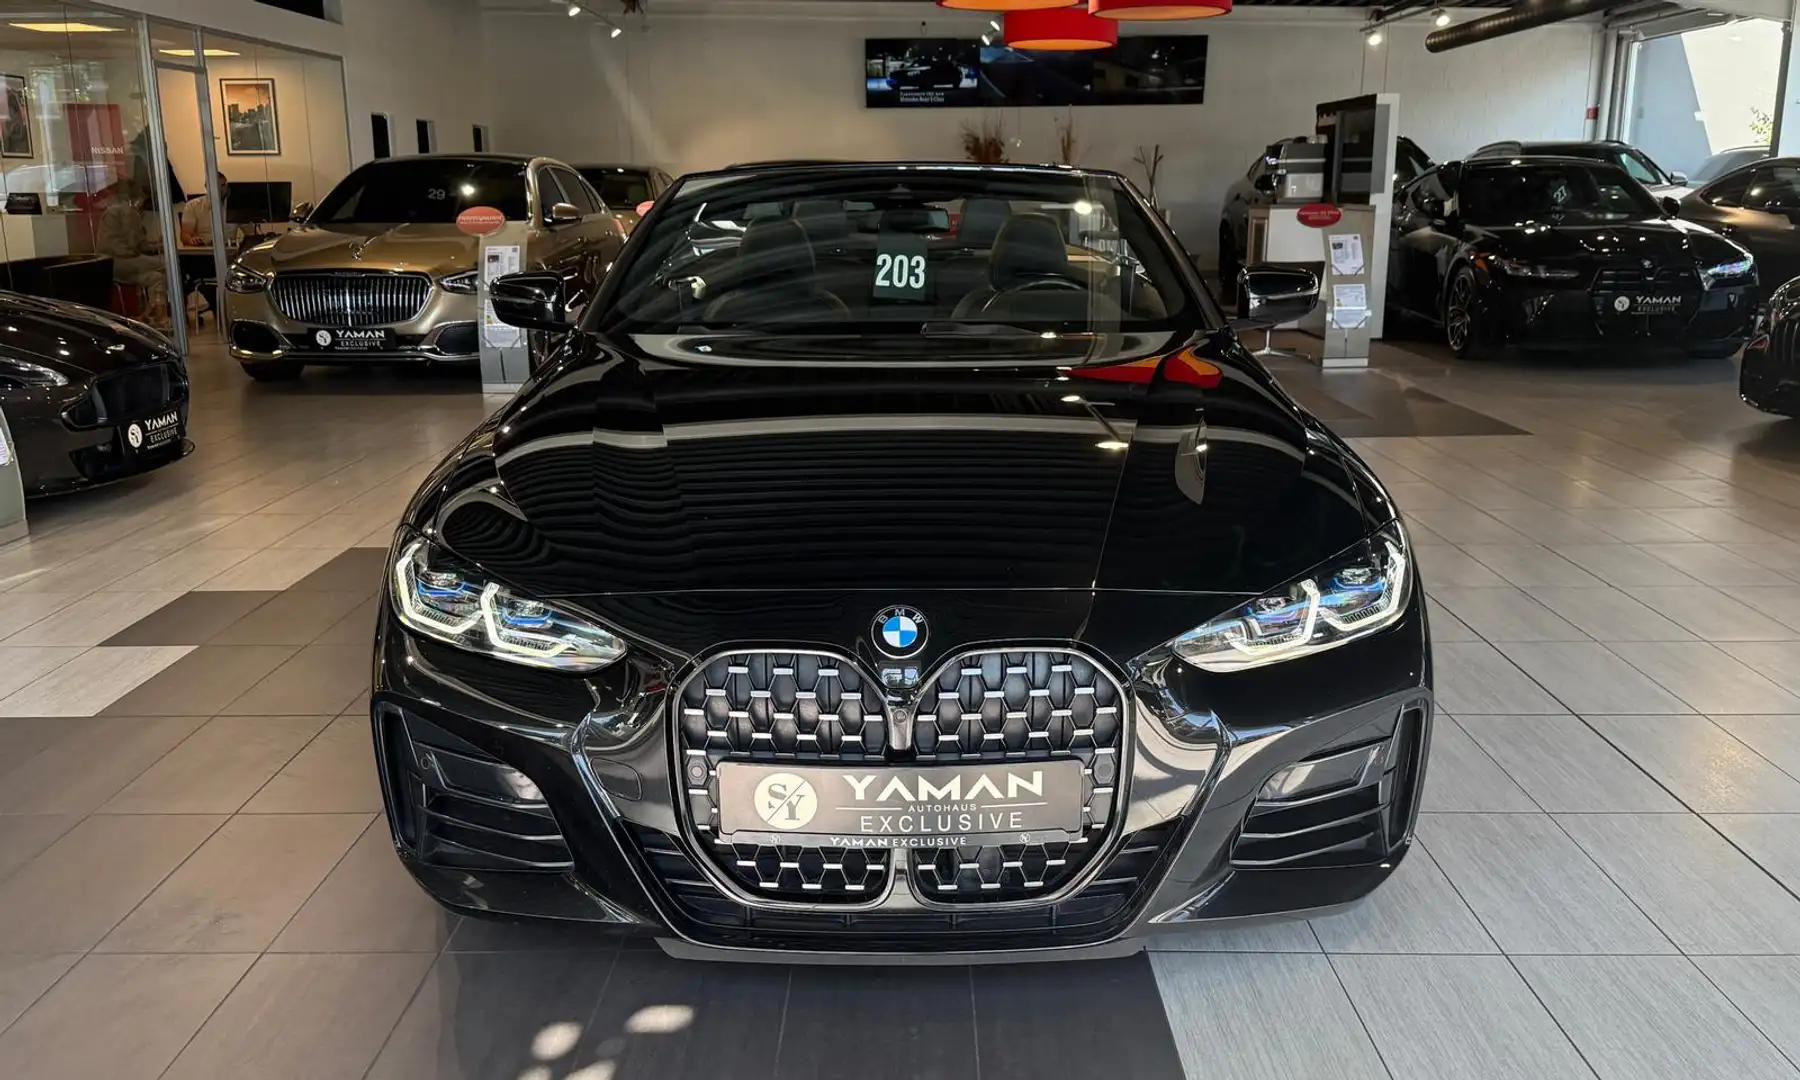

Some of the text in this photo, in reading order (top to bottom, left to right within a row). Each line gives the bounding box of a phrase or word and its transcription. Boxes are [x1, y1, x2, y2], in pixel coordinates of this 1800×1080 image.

[427, 188, 446, 200] 29
[875, 253, 926, 289] 203
[1636, 295, 1682, 304] YAMAN
[336, 329, 385, 338] YAMAN
[144, 411, 178, 431] YAMAN
[878, 608, 923, 624] BMW
[842, 771, 1043, 802] YAMAN
[908, 803, 977, 813] AUTOHAUS
[861, 811, 1023, 833] EXCLUSIVE
[830, 836, 967, 847] YAMAN EXCLUSIVE
